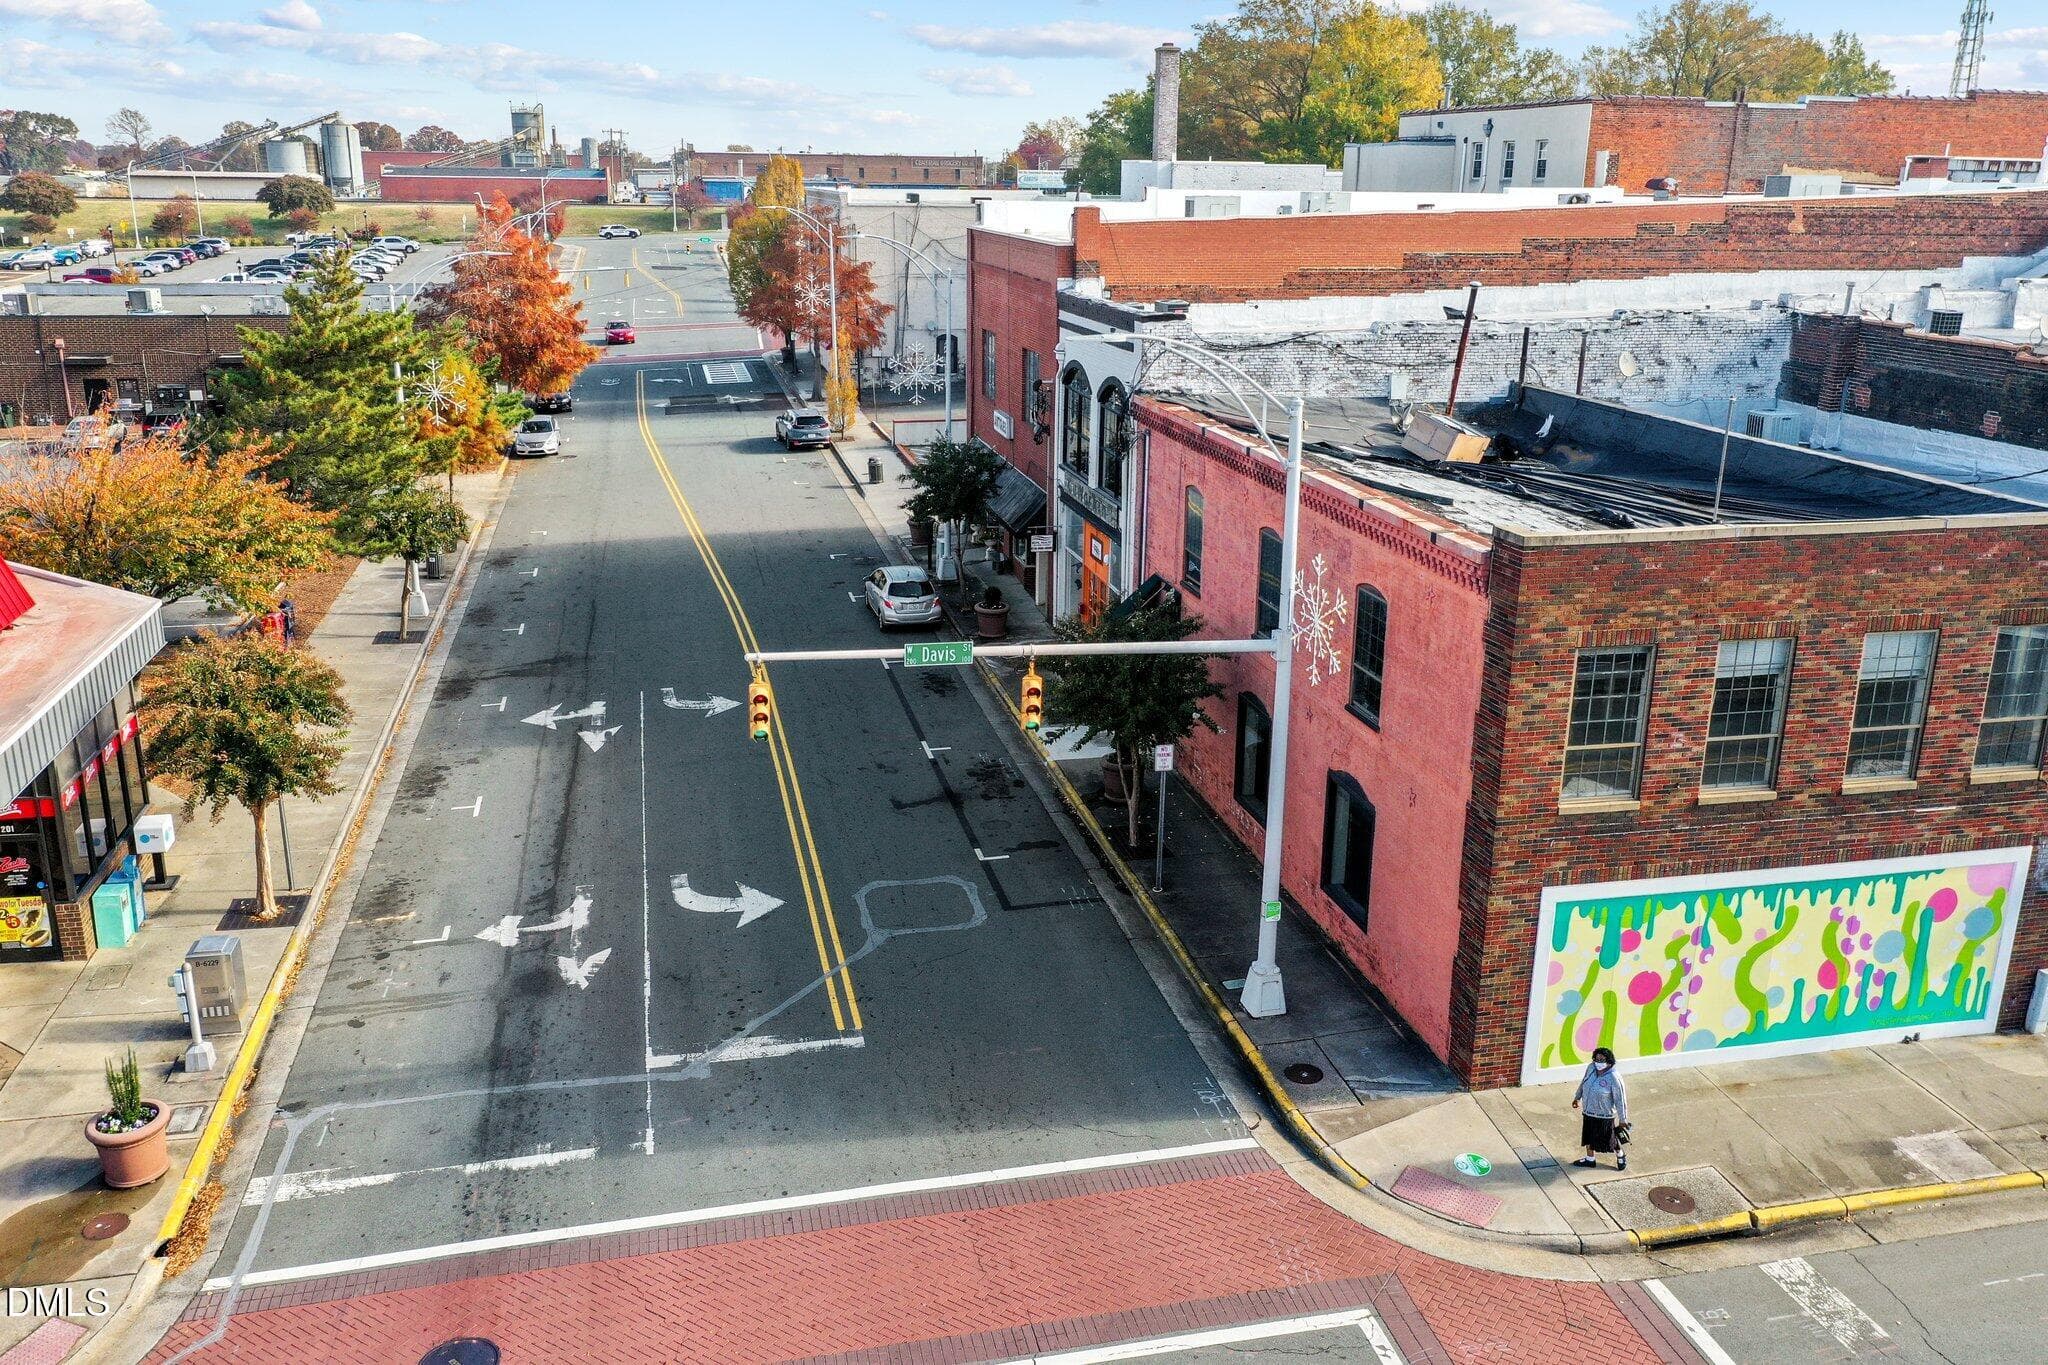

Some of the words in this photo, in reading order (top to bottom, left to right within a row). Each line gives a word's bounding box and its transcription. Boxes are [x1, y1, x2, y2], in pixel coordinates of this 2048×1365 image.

[906, 646, 913, 654] W
[922, 646, 956, 662] Davis
[962, 643, 971, 652] St
[0, 825, 15, 833] 201
[0, 910, 6, 919] 2
